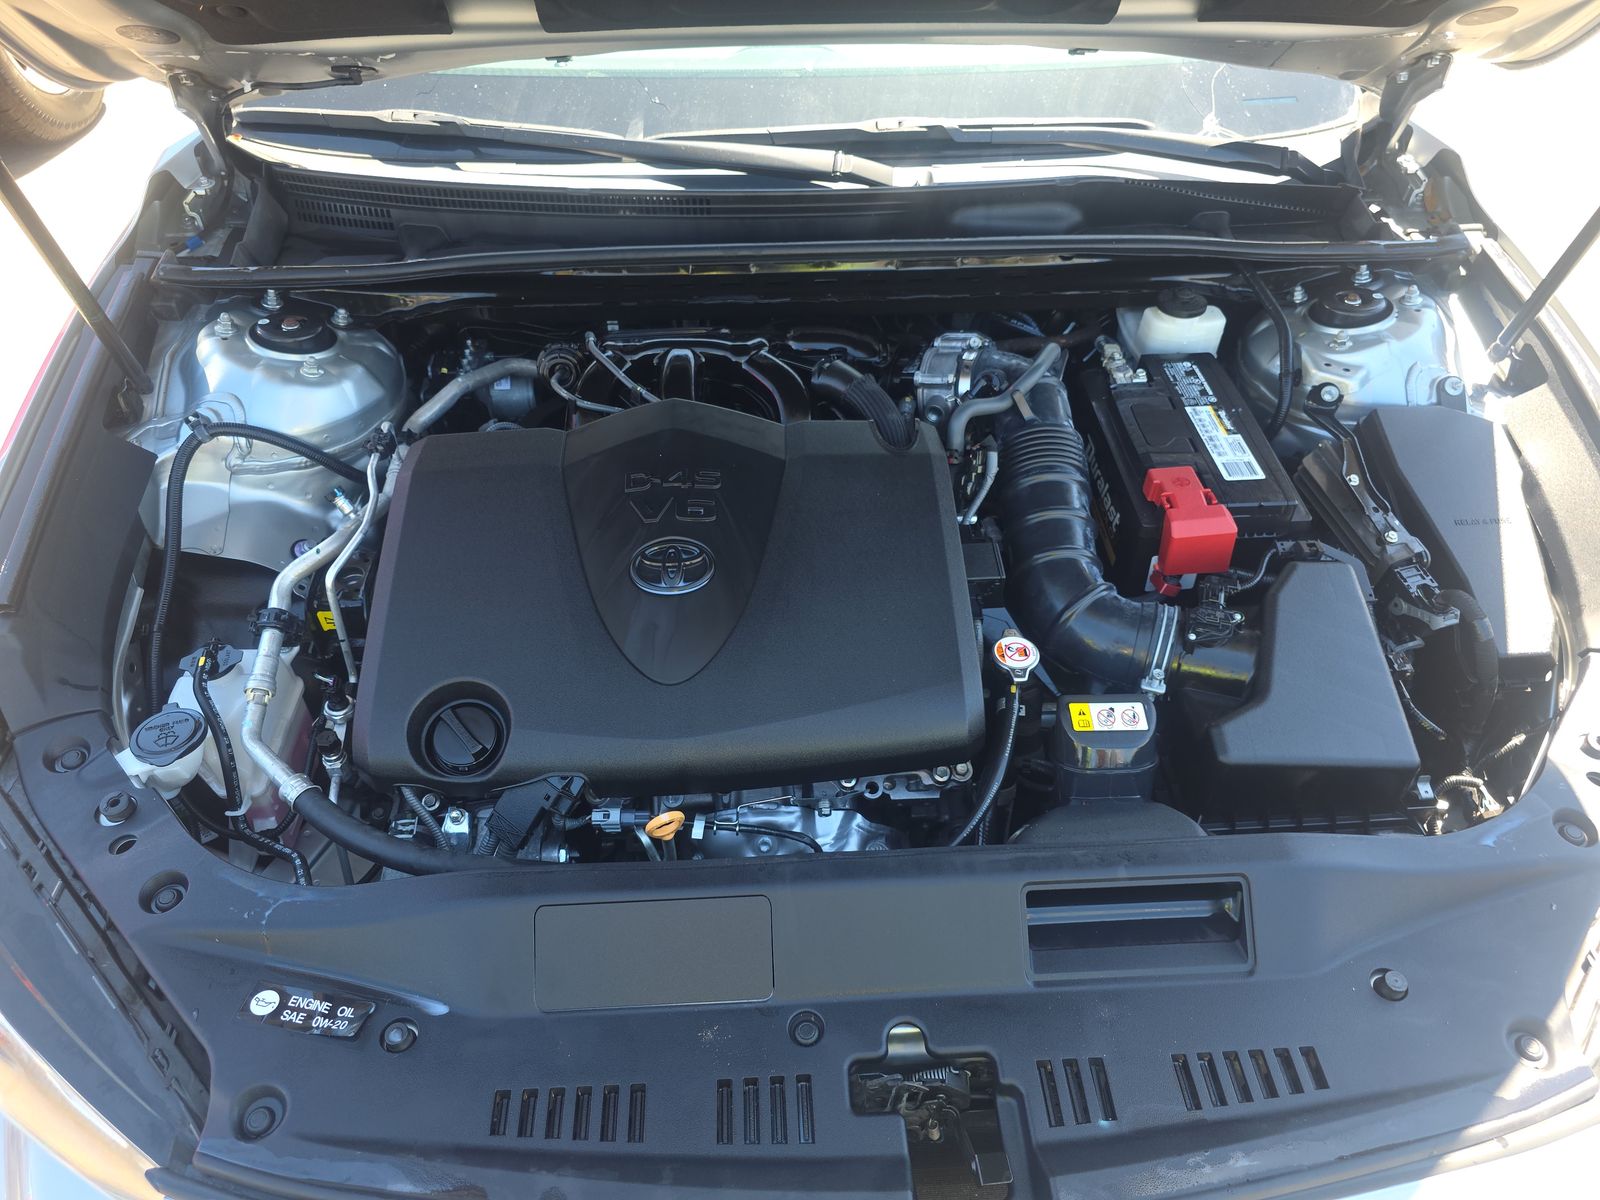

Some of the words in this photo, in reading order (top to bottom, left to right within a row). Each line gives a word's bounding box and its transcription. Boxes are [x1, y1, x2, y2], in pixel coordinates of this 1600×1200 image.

[625, 471, 721, 493] D-4S
[629, 497, 717, 523] V6
[288, 995, 332, 1014] ENGINE
[337, 1006, 355, 1018] OIL
[280, 1010, 307, 1024] SAE
[311, 1016, 349, 1030] 0W-20
